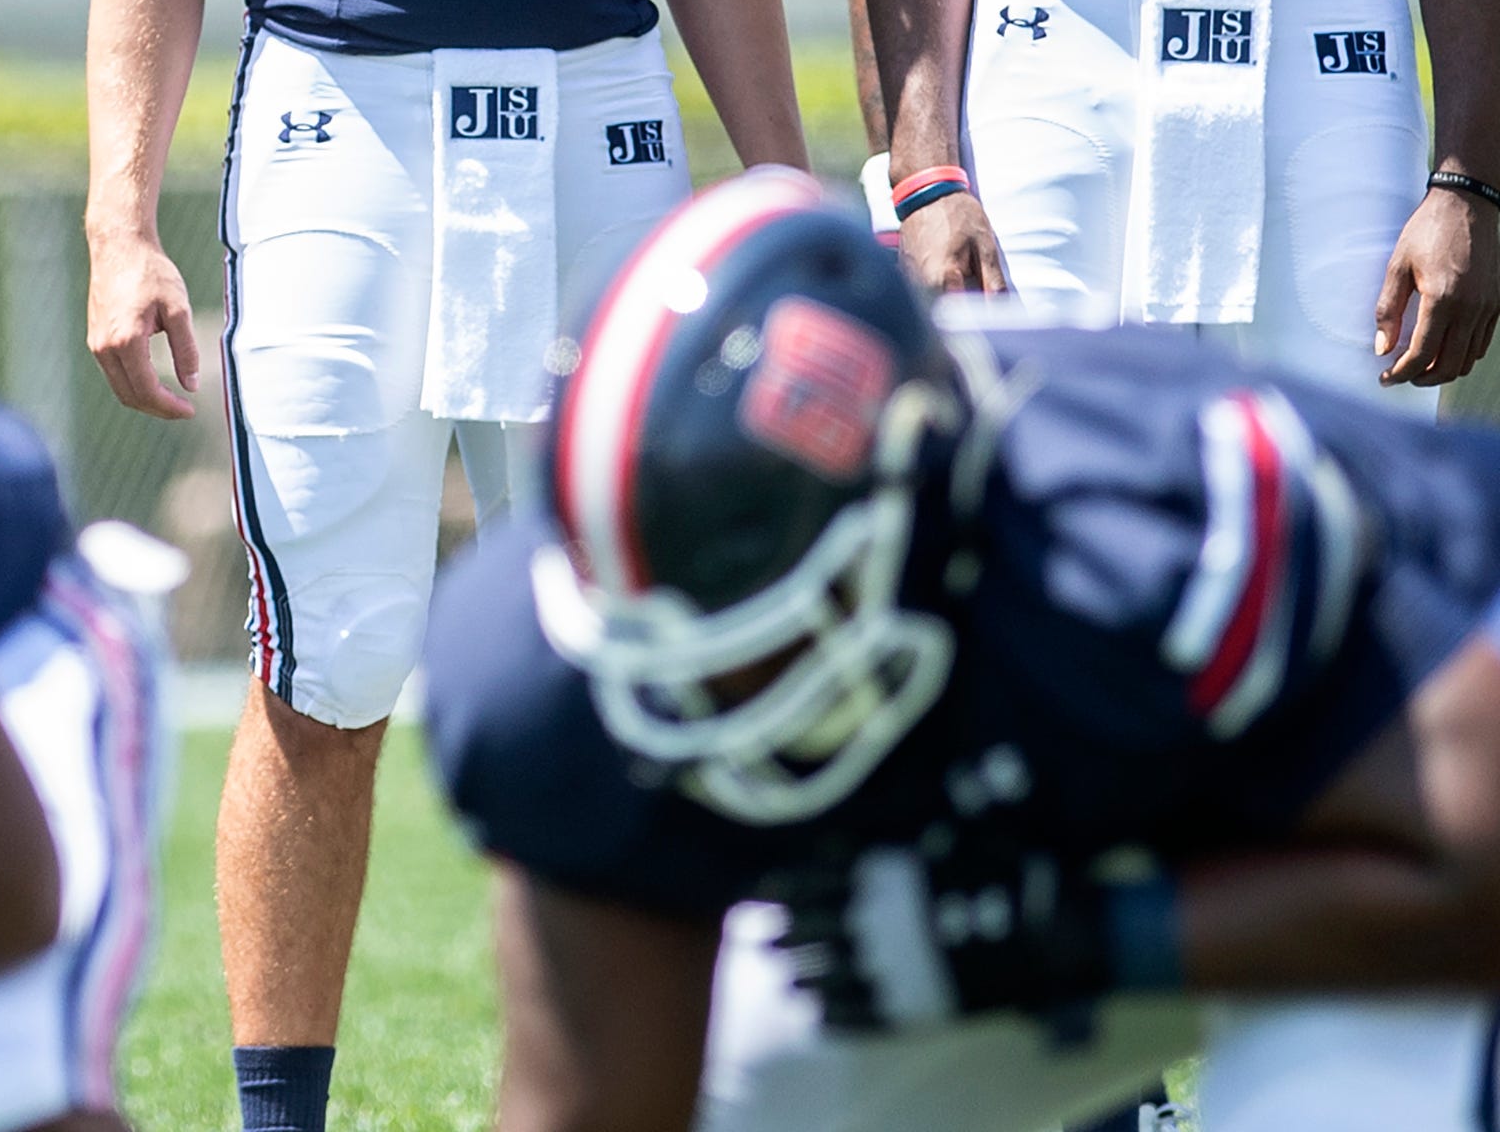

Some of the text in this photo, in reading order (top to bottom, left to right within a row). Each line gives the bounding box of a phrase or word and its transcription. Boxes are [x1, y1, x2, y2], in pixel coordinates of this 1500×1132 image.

[1165, 9, 1245, 64] JSU
[1320, 31, 1383, 75] JSU
[454, 86, 531, 139] JSU
[610, 121, 662, 164] JSU
